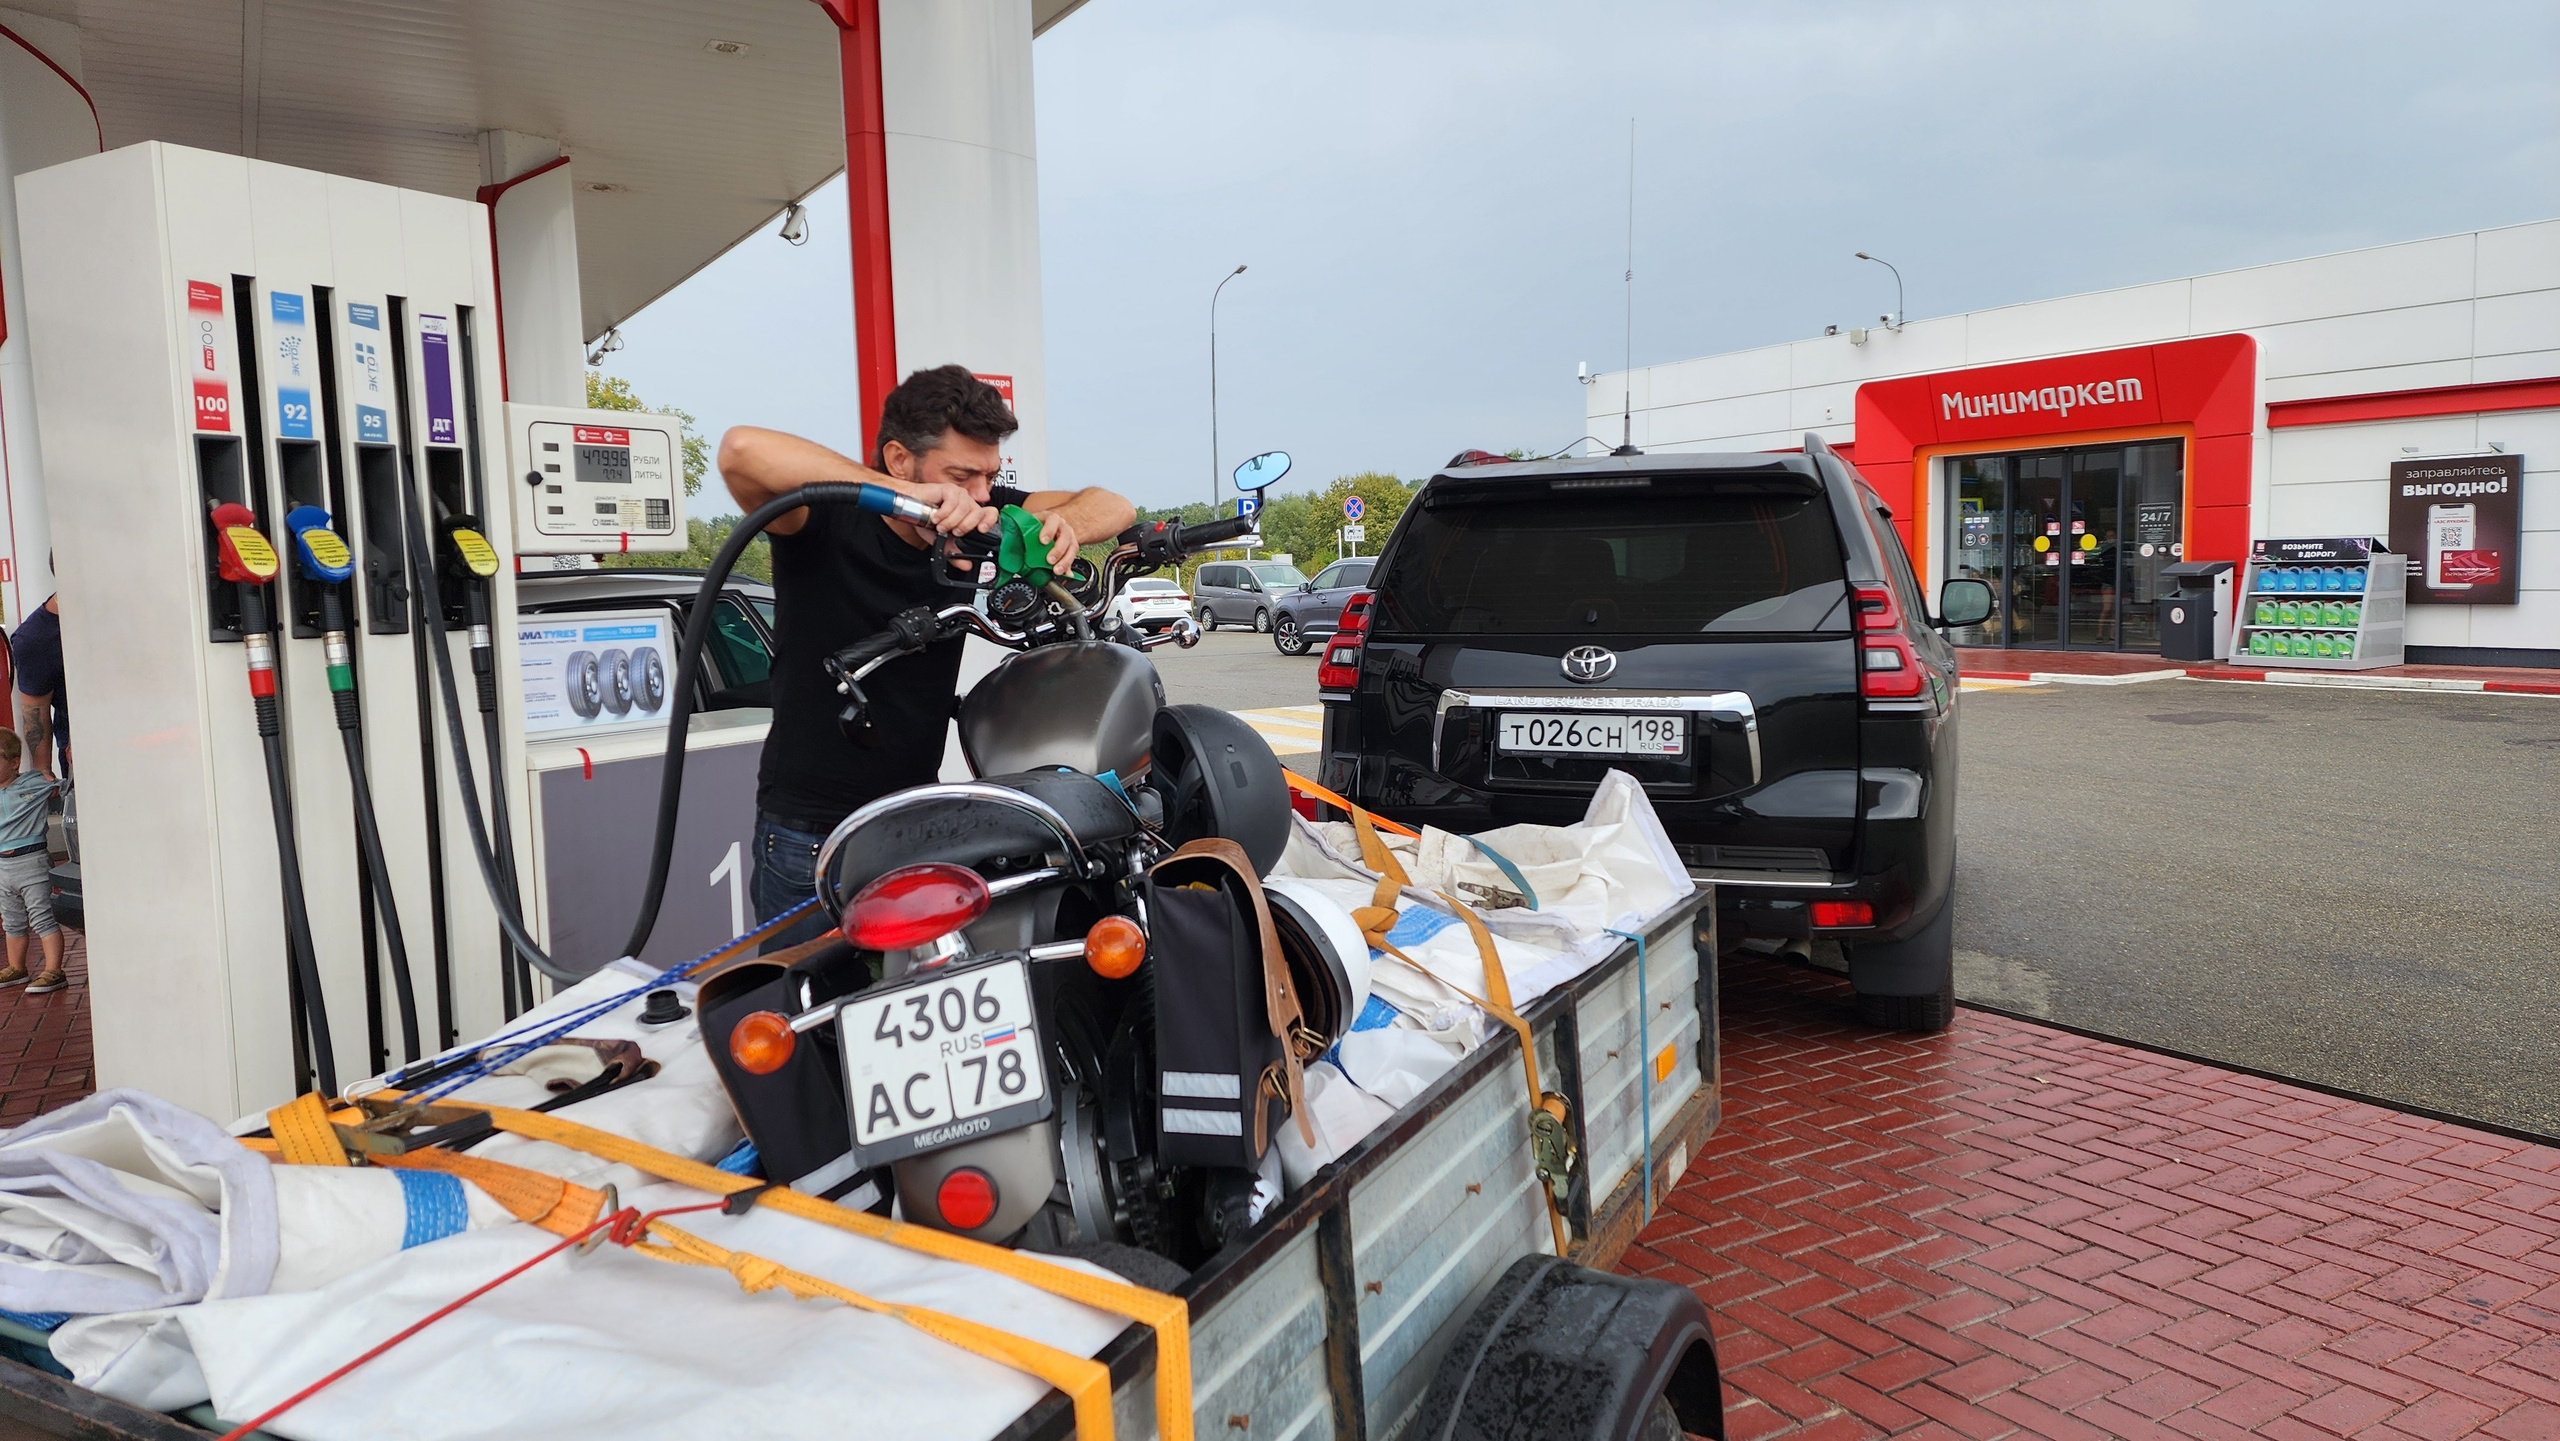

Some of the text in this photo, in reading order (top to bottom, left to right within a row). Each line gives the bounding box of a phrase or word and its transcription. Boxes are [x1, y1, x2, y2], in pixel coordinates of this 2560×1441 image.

[196, 396, 227, 412] 100
[1941, 377, 2143, 421] Минимаркет
[284, 404, 307, 420] 92
[363, 415, 381, 428] 95
[432, 418, 452, 433] ДТ
[633, 455, 660, 465] РУБЛИ
[634, 471, 662, 480] ЛИТРЫ
[2406, 465, 2506, 479] заправляйтесь
[2402, 476, 2508, 497] выгодно!
[1243, 500, 1255, 515] P
[2140, 512, 2171, 521] 24/7
[543, 629, 577, 639] TYRES
[1495, 696, 1684, 709] LAND CRUISER PRADO
[1510, 718, 1674, 749] Т026СН 198
[1640, 742, 1663, 751] RUS
[709, 841, 744, 940] 1
[874, 977, 1000, 1048] 4306
[940, 1033, 982, 1058] RUS
[867, 1049, 1026, 1135] АС 78
[913, 1117, 991, 1149] MEGAMOTO
